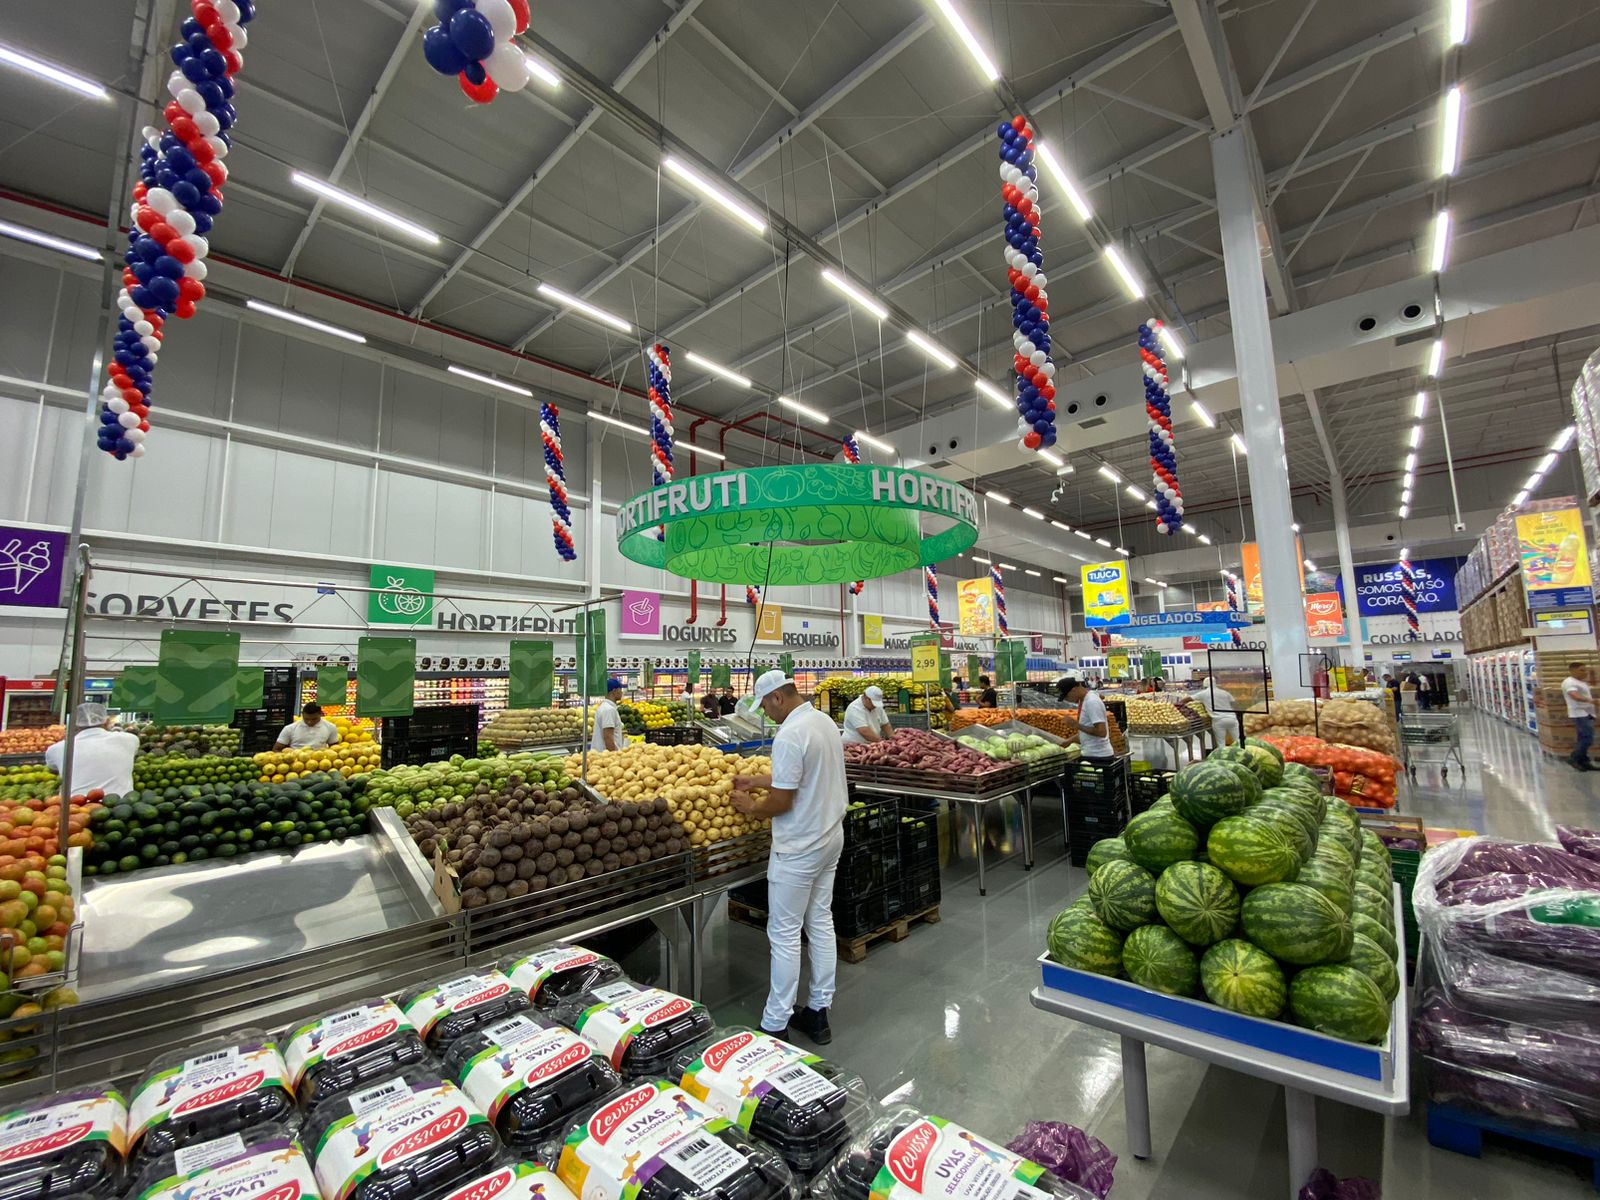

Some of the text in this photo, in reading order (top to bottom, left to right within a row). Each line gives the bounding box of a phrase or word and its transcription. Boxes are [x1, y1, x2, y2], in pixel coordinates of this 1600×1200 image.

[1089, 569, 1118, 580] TIJUCA
[1357, 583, 1402, 595] SOMOS
[1425, 578, 1445, 590] SÓ
[1367, 591, 1440, 607] CORAÃO.
[662, 624, 737, 643] IOGURTES
[783, 631, 840, 648] REQUEIJÃO
[916, 658, 935, 669] 2,99
[647, 1001, 688, 1023] Levissa
[525, 1042, 562, 1062] UVAS
[532, 1045, 586, 1079] Levissa
[708, 1034, 750, 1067] Levissa
[735, 1045, 767, 1065] UVAS
[192, 1071, 237, 1090] UVAS
[387, 1109, 435, 1134] UVAS
[594, 1088, 652, 1138] Levissa
[626, 1108, 667, 1135] UVAS
[388, 1110, 462, 1160] Levissa
[624, 1110, 680, 1146] SELECIONADAS
[894, 1126, 933, 1183] Levissa
[934, 1149, 966, 1179] UVAS
[945, 1152, 981, 1196] SELECIONADAS
